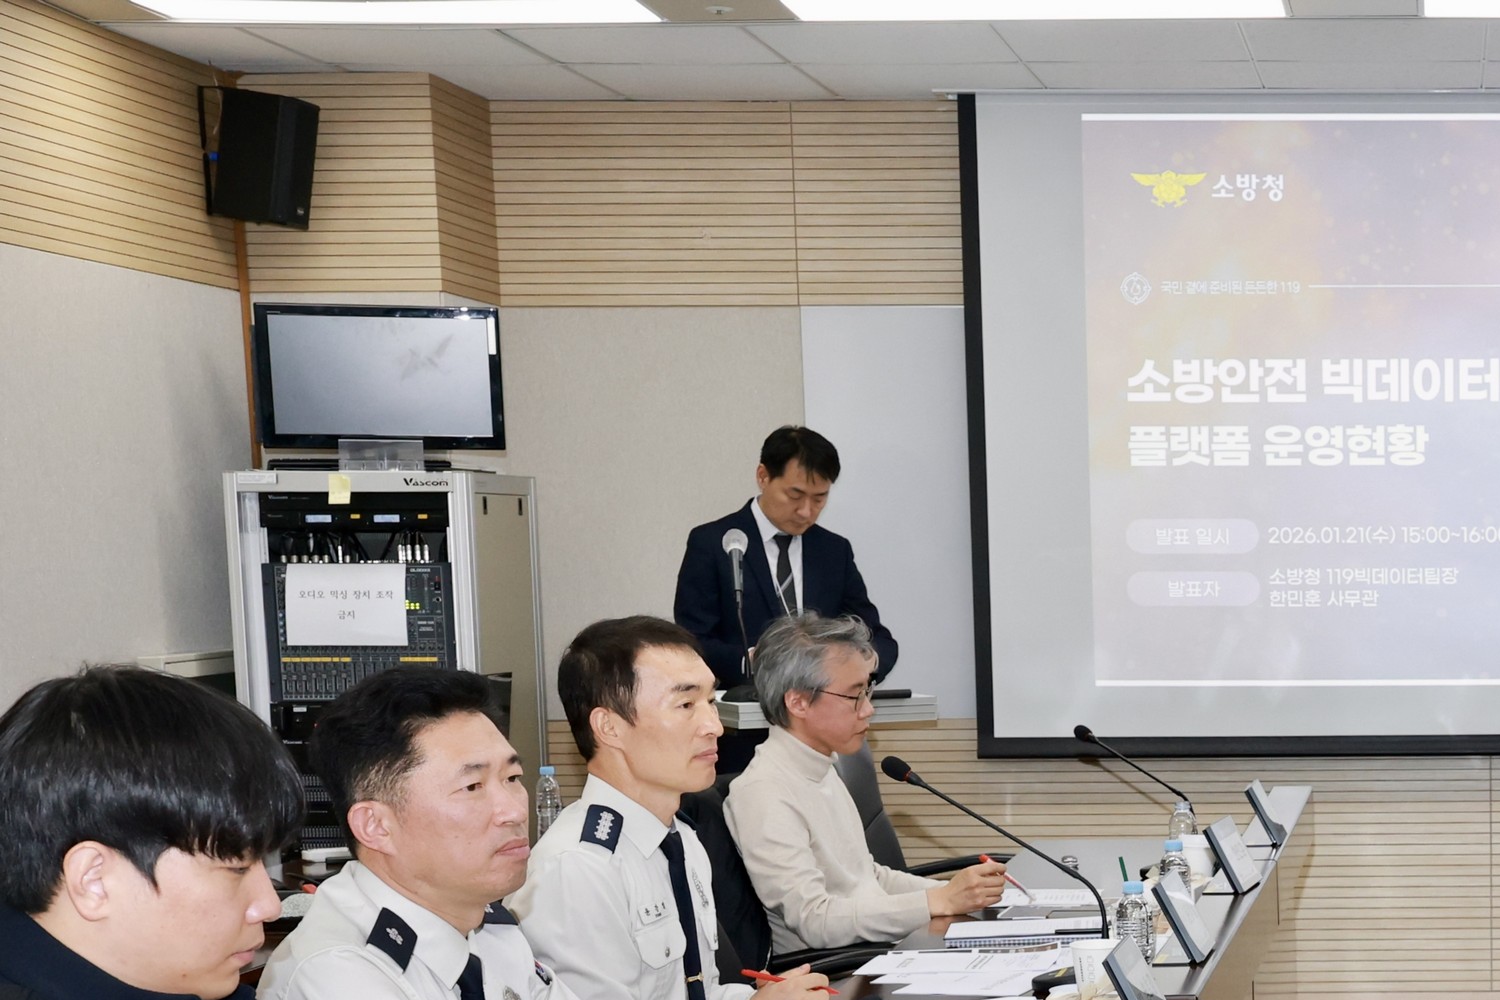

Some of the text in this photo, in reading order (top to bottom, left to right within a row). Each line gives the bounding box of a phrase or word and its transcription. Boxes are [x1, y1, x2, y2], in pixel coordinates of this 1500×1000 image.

[1211, 173, 1284, 202] 소방청
[1160, 281, 1182, 294] 국민
[1244, 281, 1277, 294] 든든한
[1281, 281, 1300, 294] 119
[1127, 357, 1500, 403] 소방안전 빅데이터
[1127, 424, 1429, 467] 플랫폼 운영현황
[403, 478, 449, 487] Vascom
[1155, 527, 1230, 546] 발표 일시
[1267, 525, 1396, 545] 2026.01.21(수)
[1268, 566, 1459, 586] 소방청 119빅데이터팀장
[299, 590, 393, 599] 오디오 믹싱 장치 조작
[1167, 580, 1221, 598] 발표자
[1269, 590, 1379, 608] 한민훈 사무관
[337, 610, 355, 620] 금지
